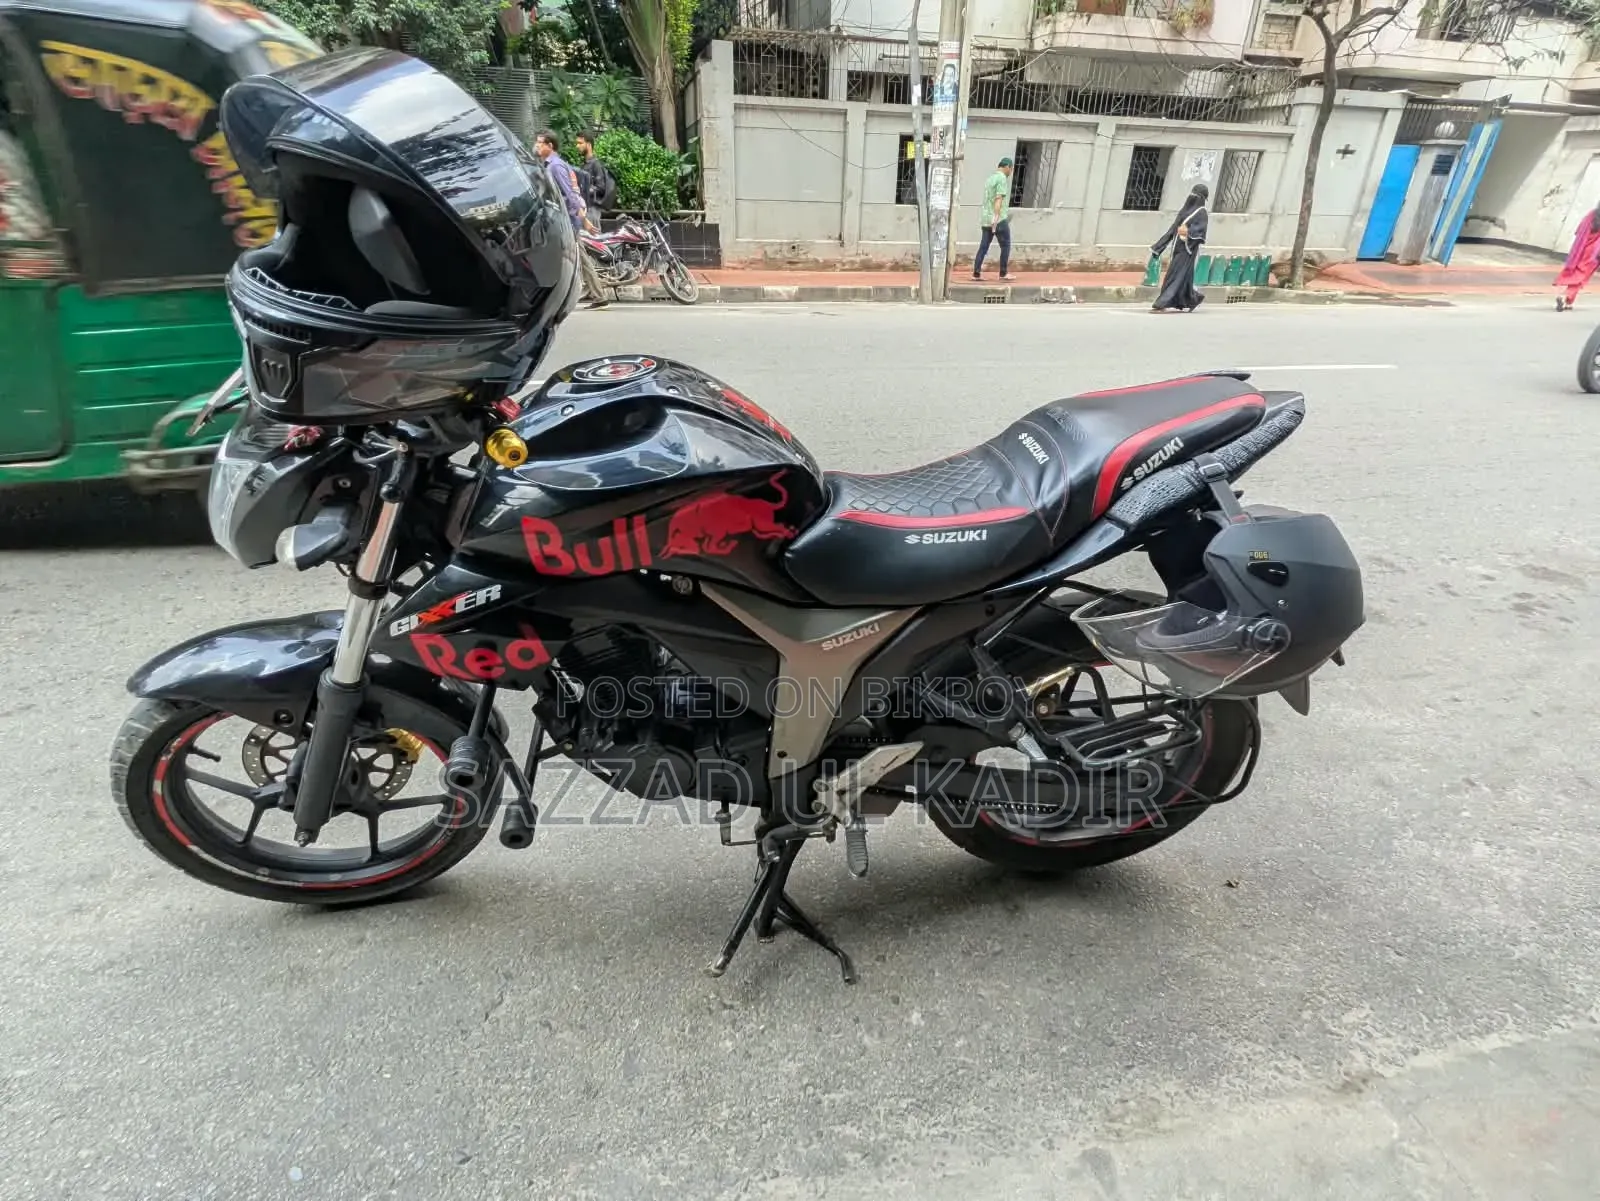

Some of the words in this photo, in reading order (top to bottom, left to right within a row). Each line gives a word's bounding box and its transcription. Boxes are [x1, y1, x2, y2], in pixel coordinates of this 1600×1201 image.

[1022, 436, 1050, 465] SUZUKI
[1132, 436, 1185, 481] SUZUKI
[521, 515, 652, 576] Bull
[921, 529, 988, 545] SUZUKI
[409, 619, 552, 682] Red
[821, 622, 881, 652] SUZUKI
